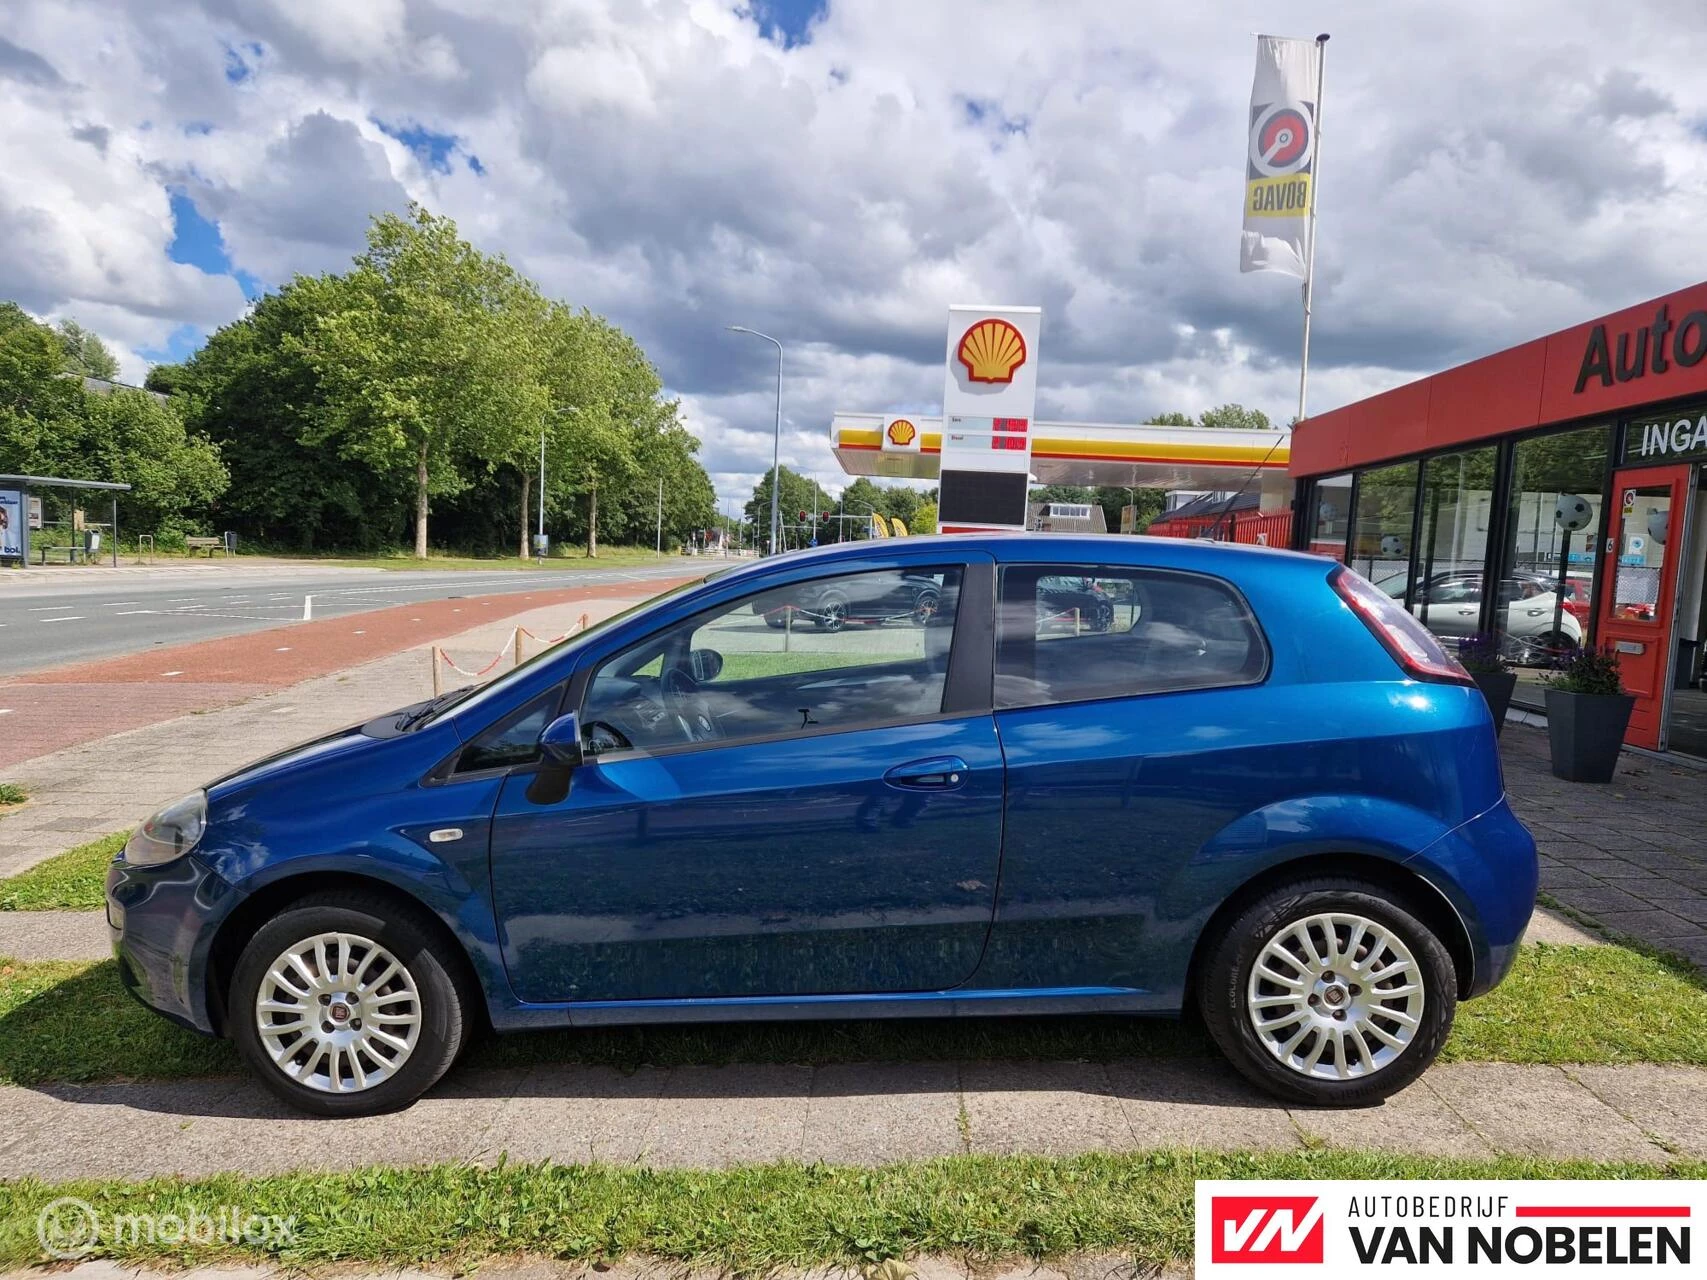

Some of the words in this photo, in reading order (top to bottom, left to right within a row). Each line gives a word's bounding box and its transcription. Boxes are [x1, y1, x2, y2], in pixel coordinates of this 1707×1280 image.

[1573, 303, 1707, 394] Auto
[1641, 415, 1707, 457] INGA
[1607, 540, 1613, 551] 6
